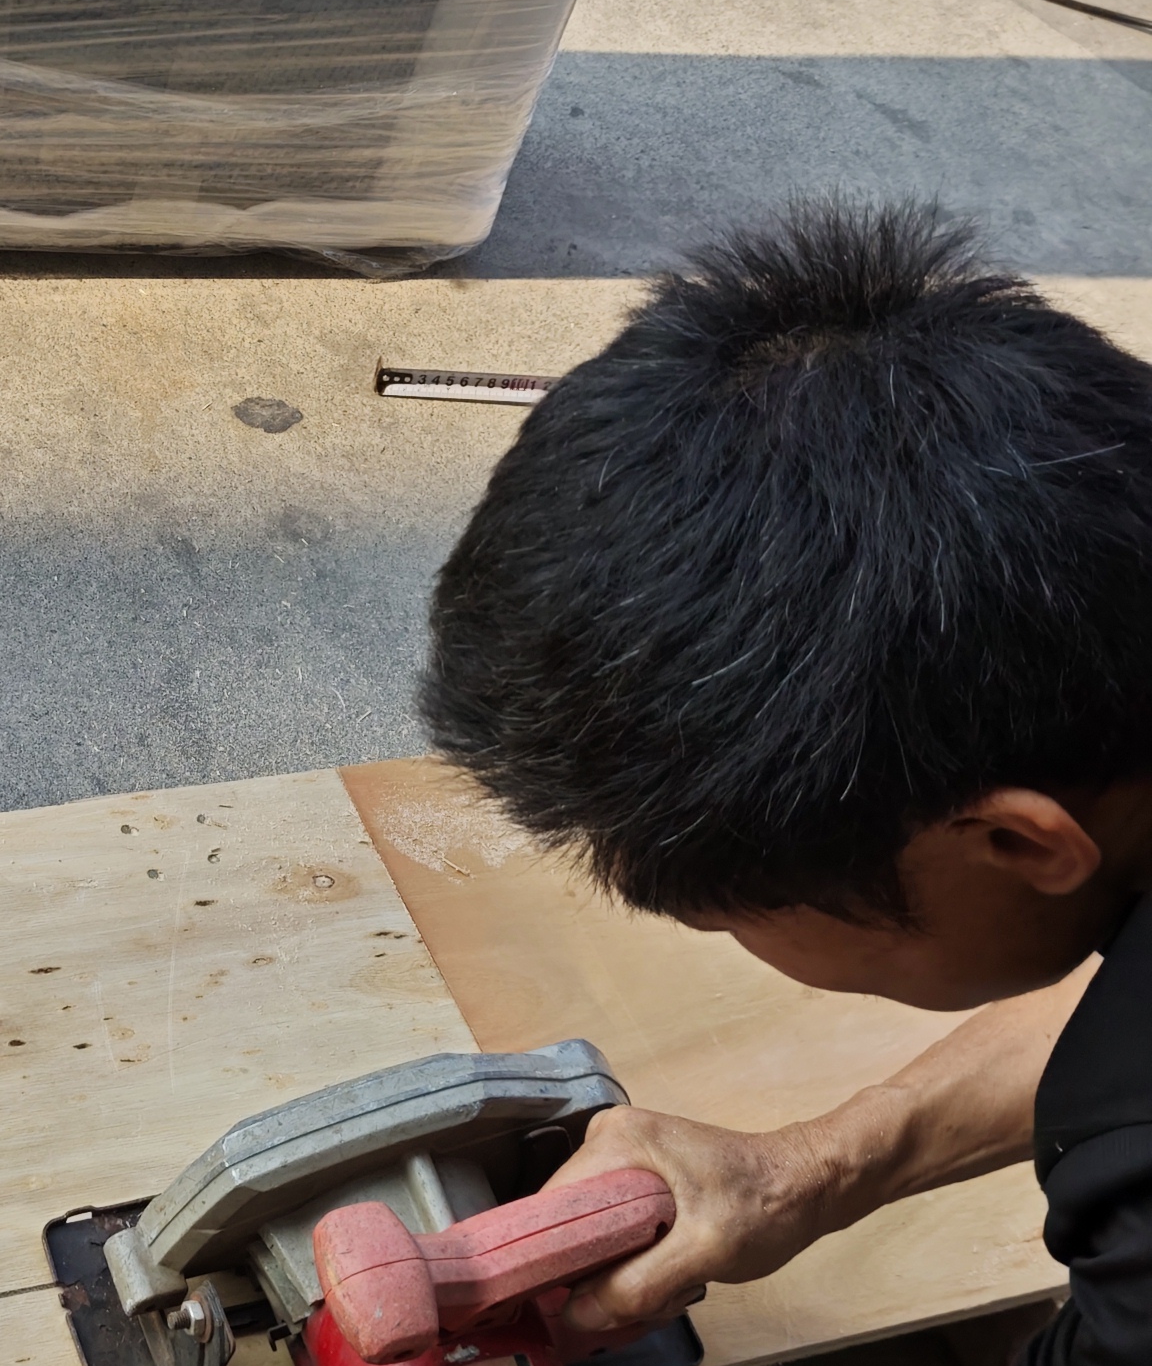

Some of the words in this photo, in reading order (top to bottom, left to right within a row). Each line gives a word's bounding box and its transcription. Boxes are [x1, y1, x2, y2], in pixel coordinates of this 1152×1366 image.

[417, 374, 427, 385] 3
[431, 375, 441, 386] 4
[445, 375, 456, 387] 5
[459, 376, 470, 388] 6
[474, 377, 484, 388] 7
[487, 377, 497, 389] 8
[500, 378, 510, 390] 9
